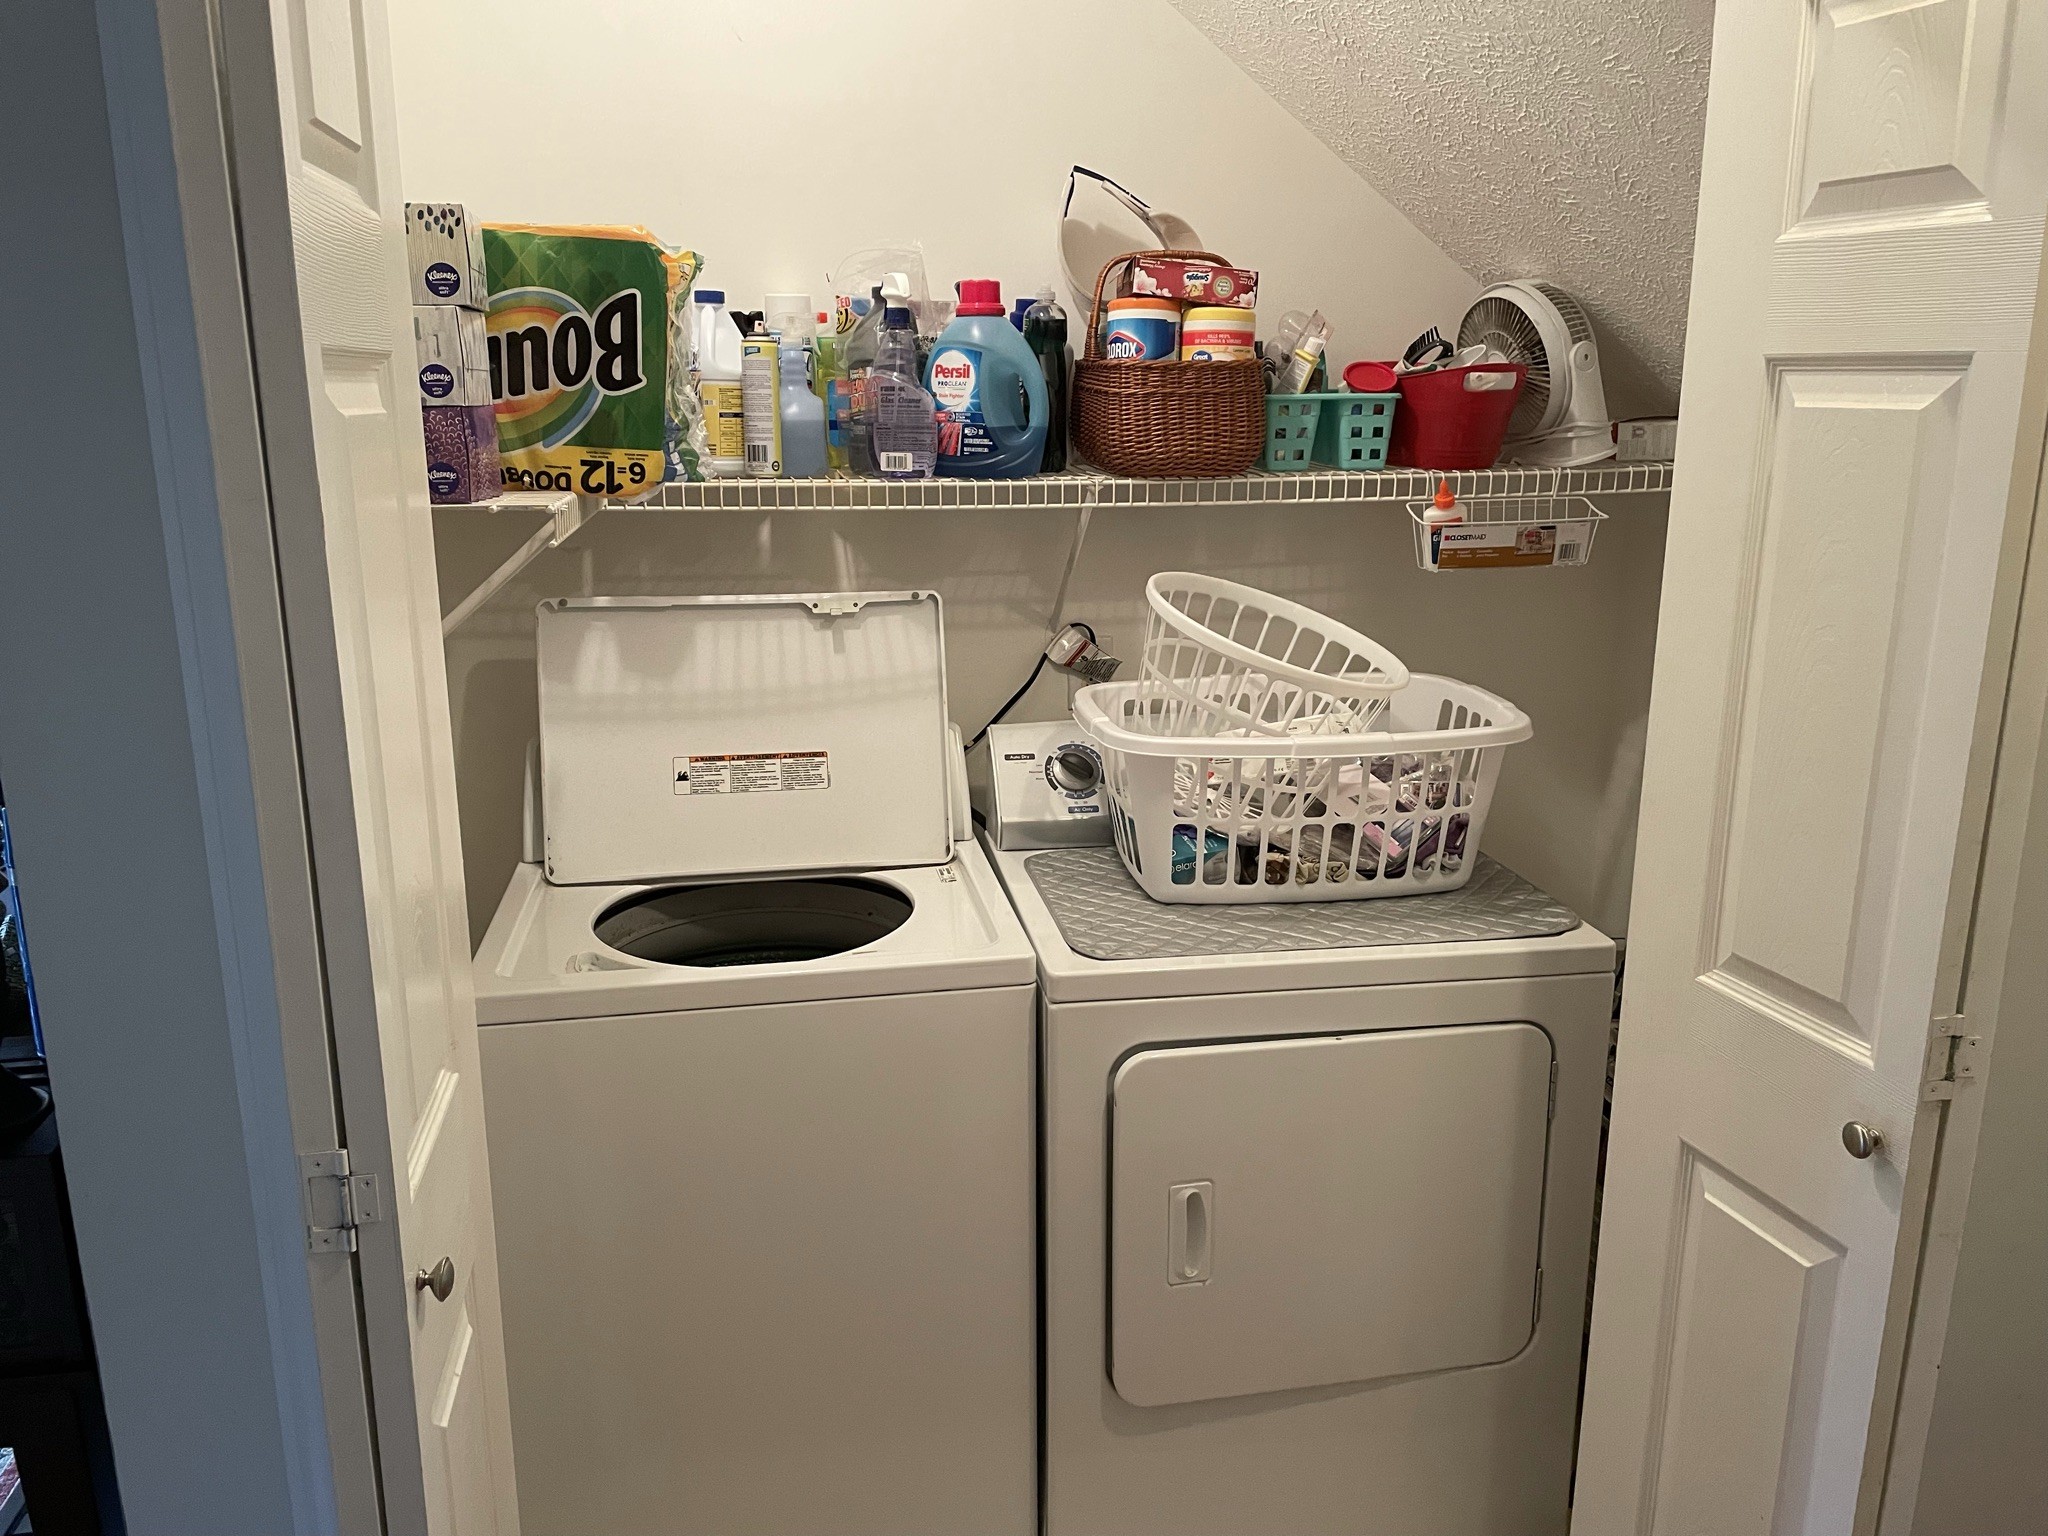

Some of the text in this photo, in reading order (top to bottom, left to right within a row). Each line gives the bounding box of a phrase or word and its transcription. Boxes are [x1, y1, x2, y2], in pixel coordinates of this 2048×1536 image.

[427, 270, 458, 281] Kleenex
[1185, 273, 1210, 282] Snuggle
[934, 363, 971, 379] Persil
[421, 371, 452, 383] Kleenex
[428, 470, 458, 481] Kleenex
[1450, 533, 1487, 541] CLOSETMAID
